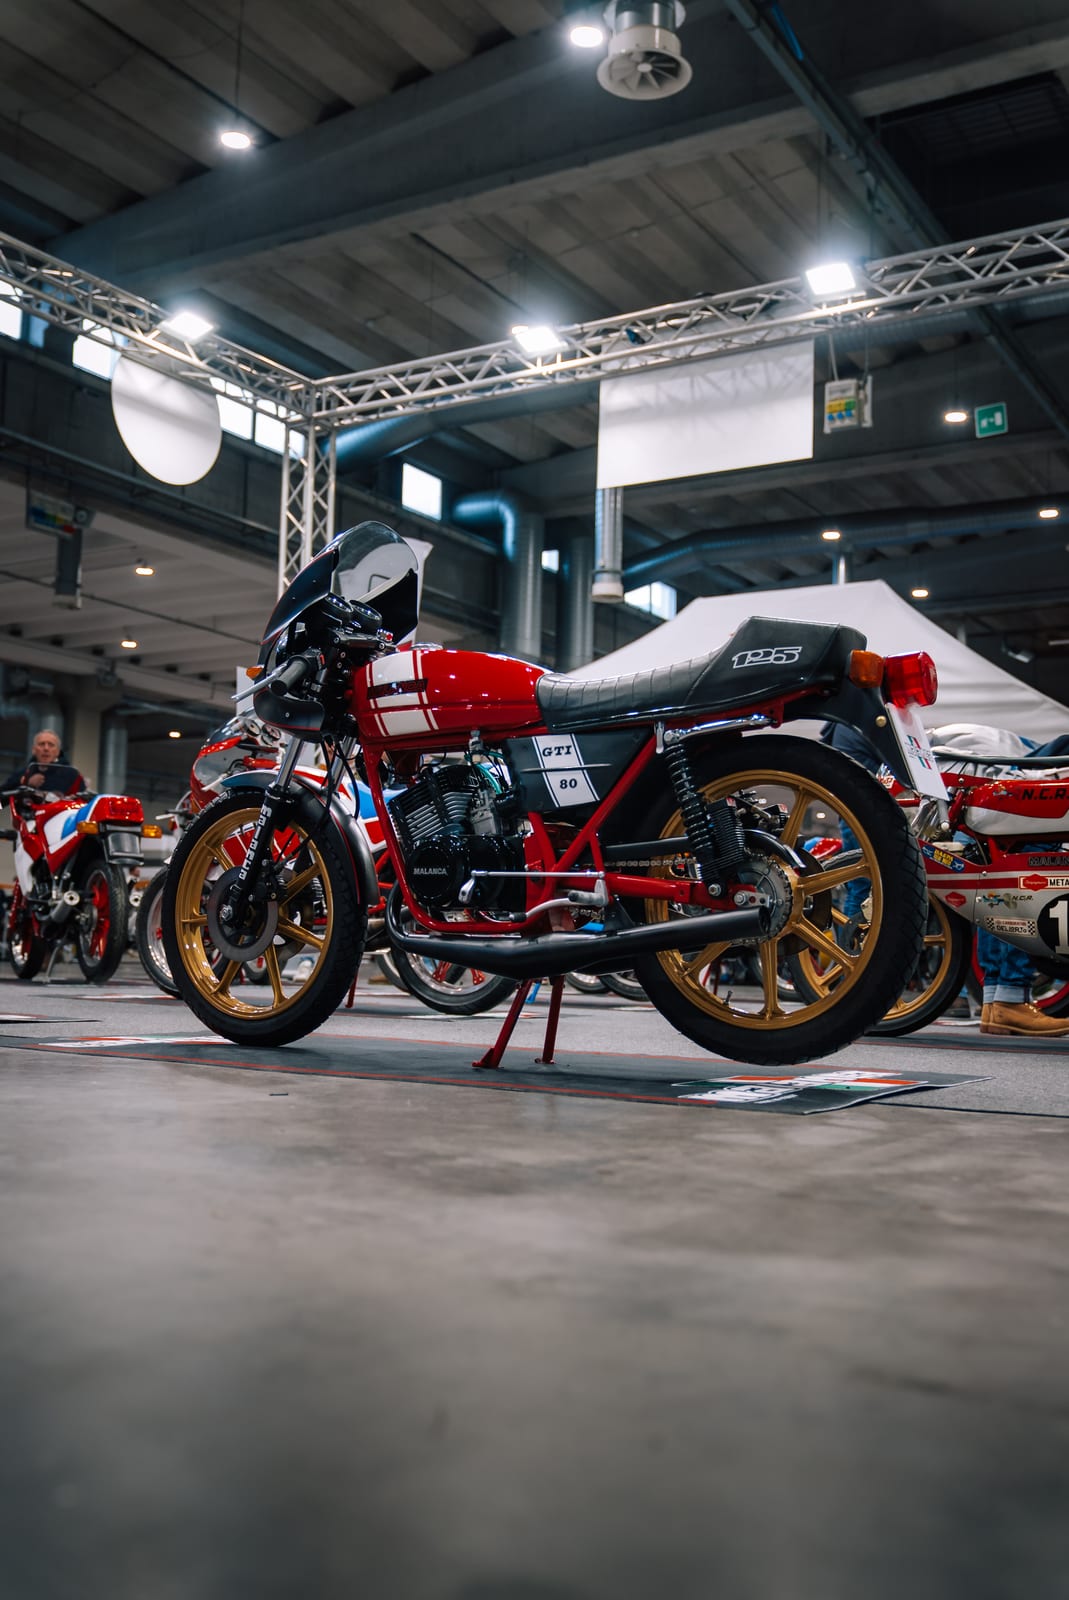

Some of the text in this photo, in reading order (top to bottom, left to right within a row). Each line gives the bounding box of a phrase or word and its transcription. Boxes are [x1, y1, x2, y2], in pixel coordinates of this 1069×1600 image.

[732, 646, 803, 669] 125
[542, 745, 572, 757] GTI
[559, 778, 577, 789] 80
[413, 867, 448, 876] MALANCA
